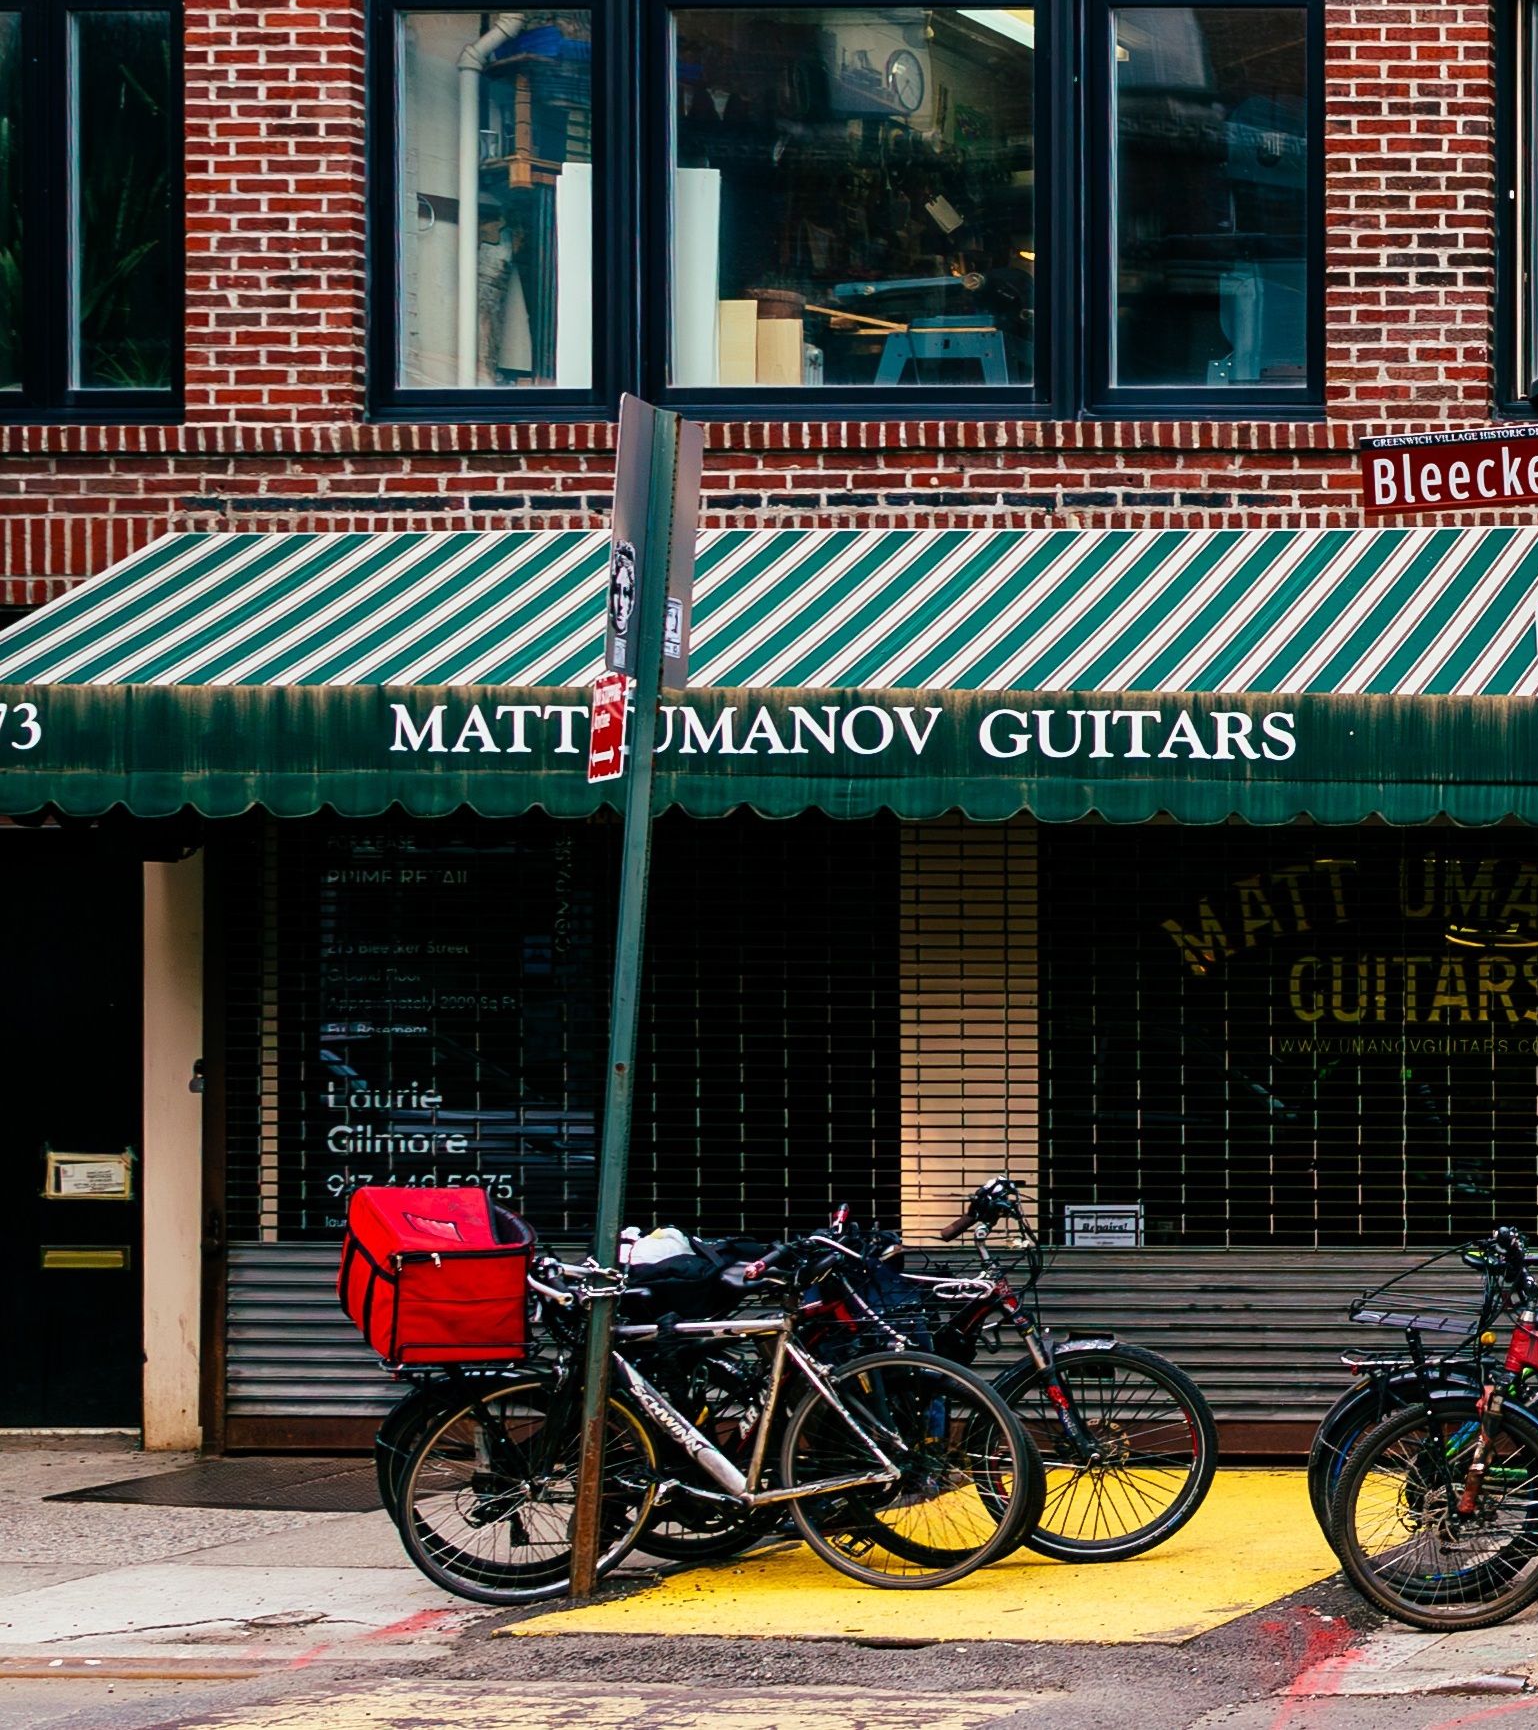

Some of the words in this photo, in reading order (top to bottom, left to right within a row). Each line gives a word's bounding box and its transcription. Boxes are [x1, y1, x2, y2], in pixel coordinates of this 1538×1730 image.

[1373, 436, 1433, 448] GREENWICH
[1434, 432, 1478, 444] VILLAGE
[1479, 428, 1525, 440] HISTORIC
[389, 703, 590, 756] MATT
[978, 706, 1297, 761] GUITARS
[1160, 858, 1358, 977] MATT
[328, 1081, 443, 1110] Laurie
[327, 1125, 469, 1155] Gilmore
[629, 1383, 703, 1452] SCHWINN
